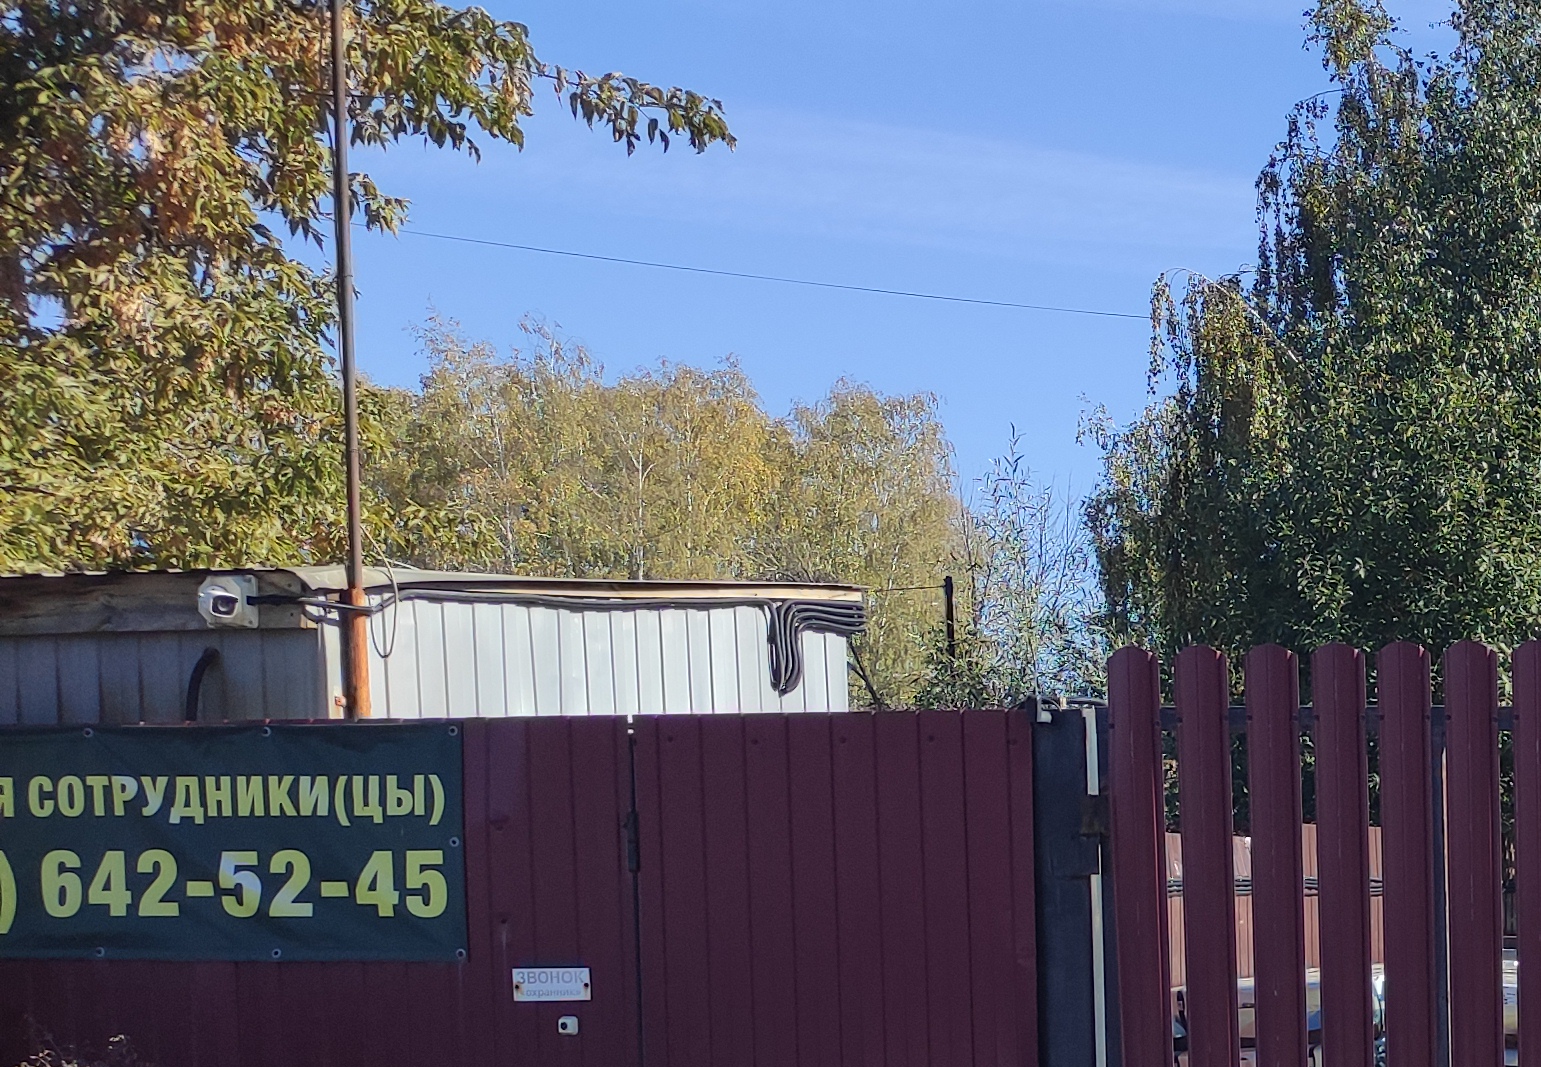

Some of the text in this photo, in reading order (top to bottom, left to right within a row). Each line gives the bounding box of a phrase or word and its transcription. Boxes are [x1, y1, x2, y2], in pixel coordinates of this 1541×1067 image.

[28, 773, 445, 826] СОТРУДНИКИ(ЦЫ)
[41, 849, 448, 918] 642-52-45
[517, 970, 584, 984] ЗВОНОК
